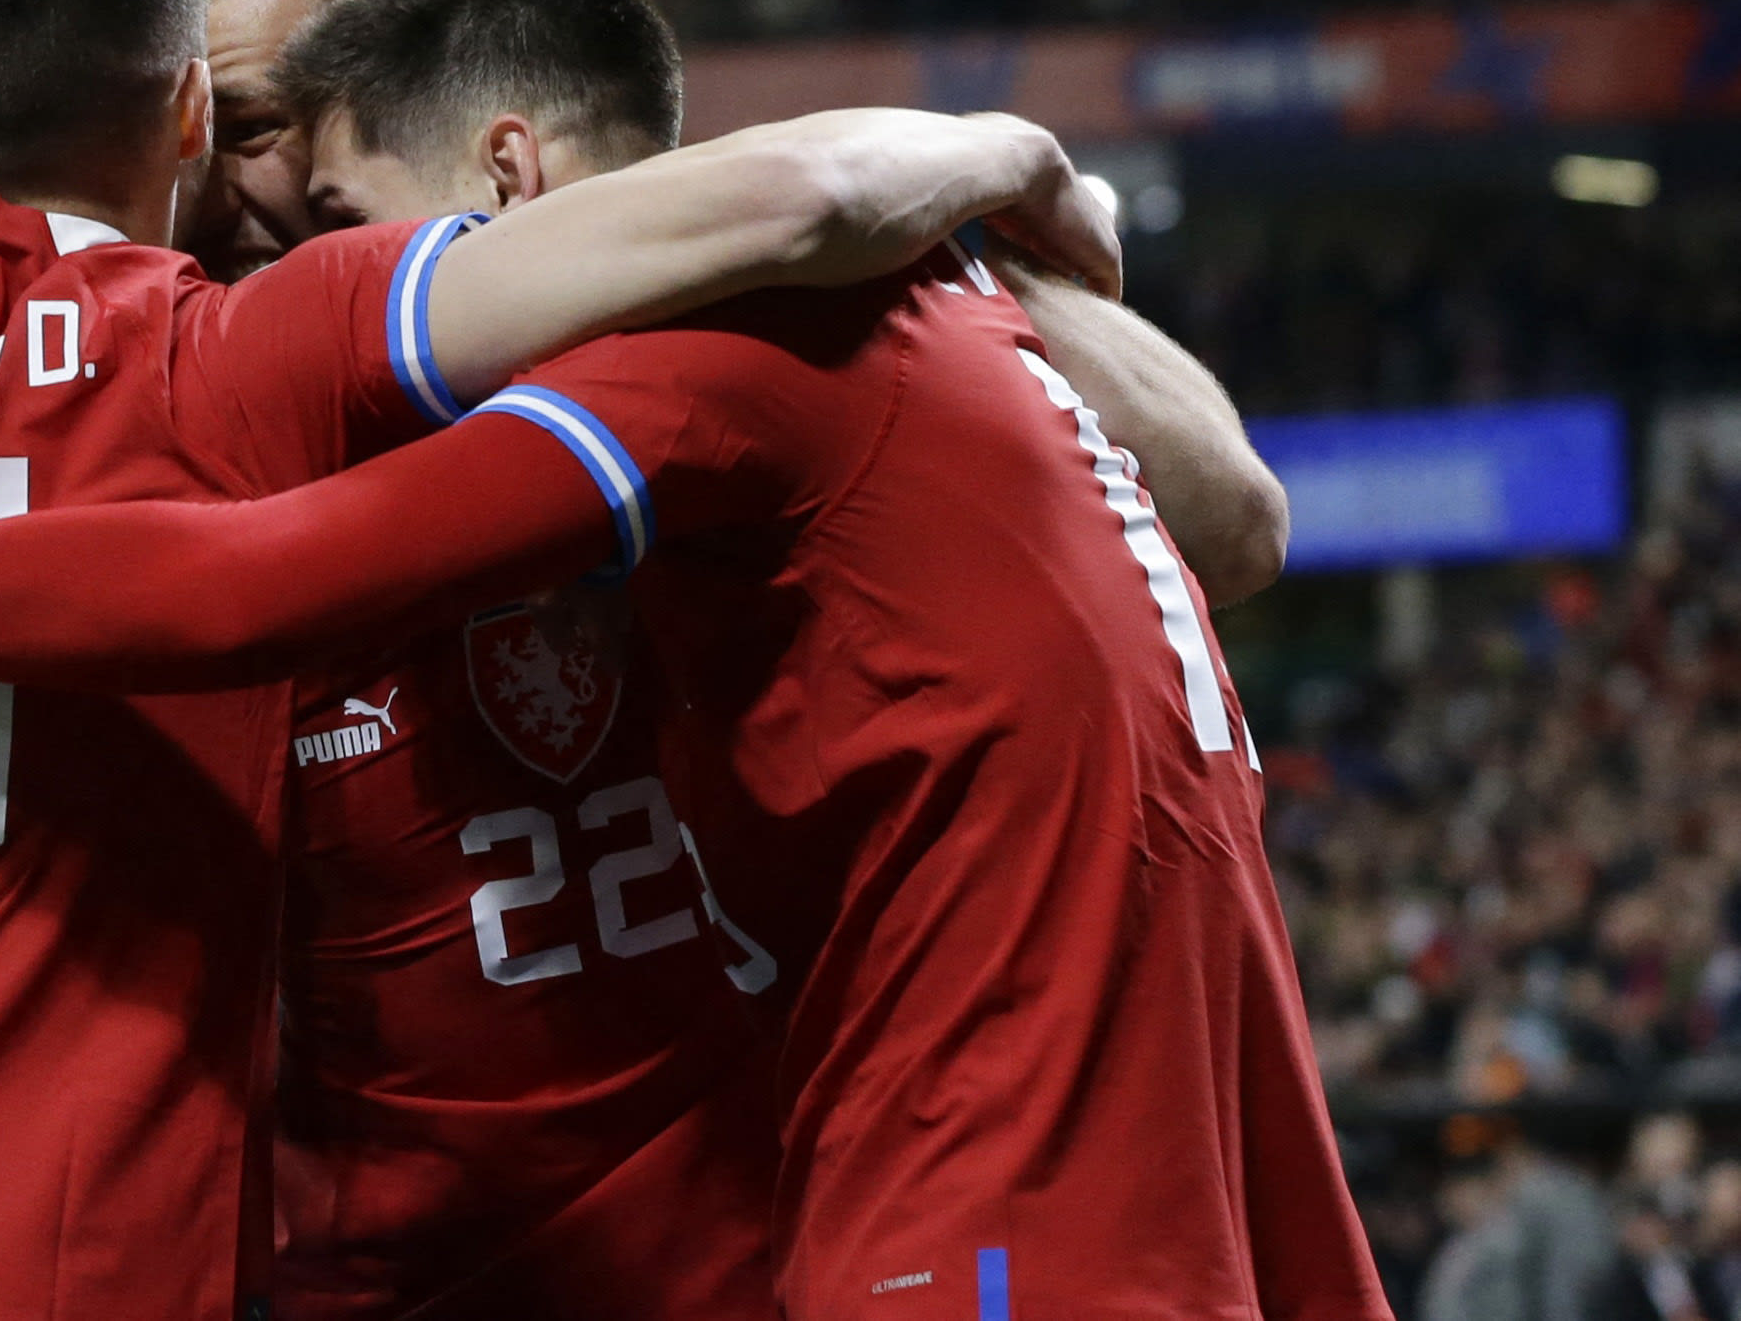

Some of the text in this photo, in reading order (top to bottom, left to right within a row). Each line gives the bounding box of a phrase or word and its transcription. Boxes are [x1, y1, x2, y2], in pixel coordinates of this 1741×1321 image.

[26, 299, 96, 387] D.
[294, 721, 382, 767] PUMA
[458, 775, 700, 987] 22
